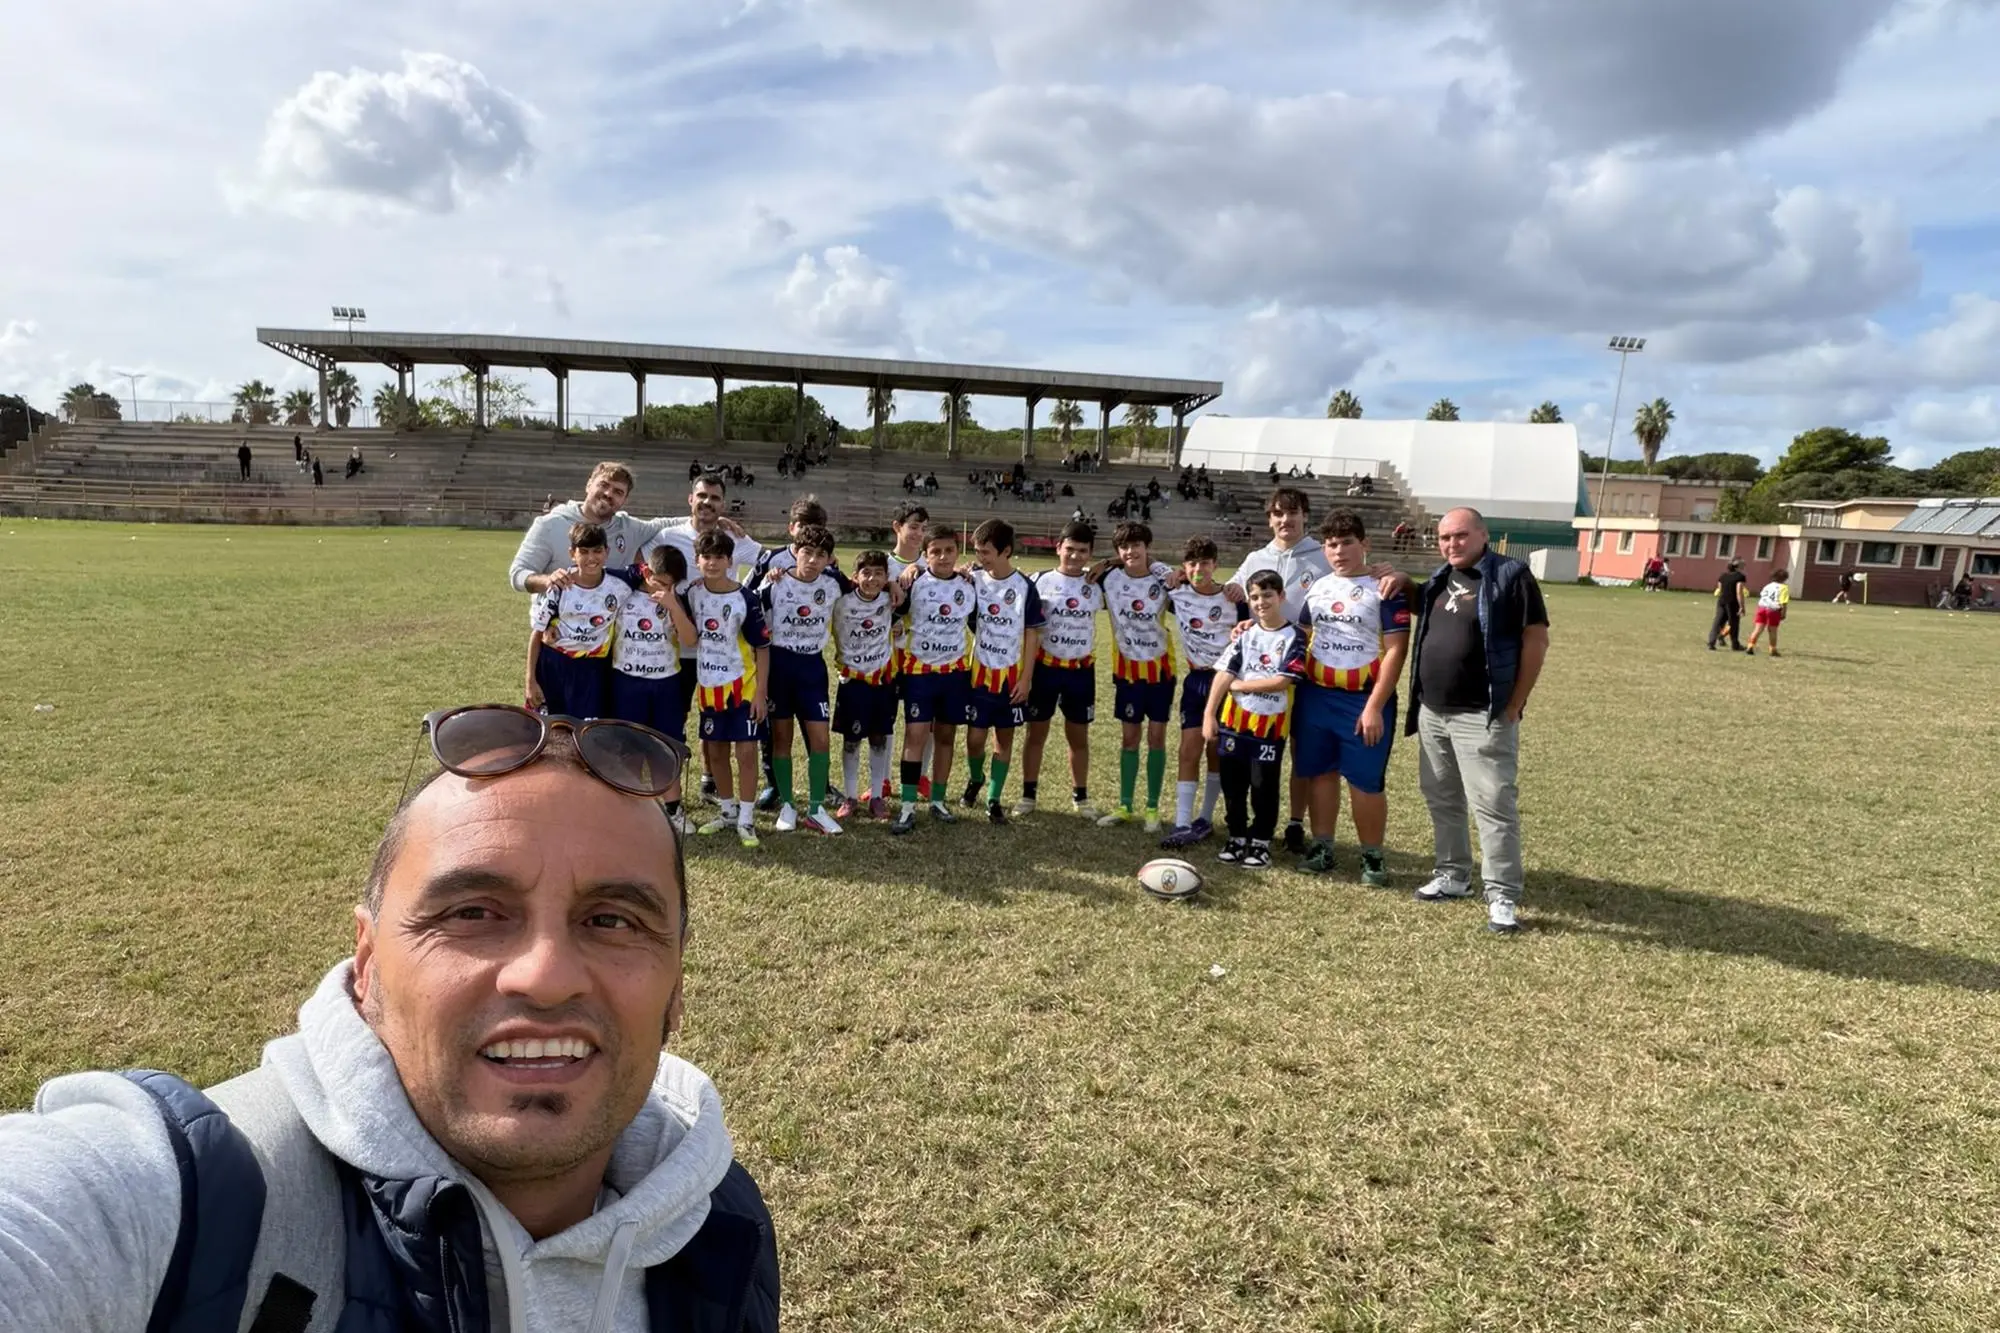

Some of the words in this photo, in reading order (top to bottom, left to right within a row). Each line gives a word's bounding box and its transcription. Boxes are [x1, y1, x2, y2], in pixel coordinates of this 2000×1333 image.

[978, 611, 1012, 625] Aragon
[1052, 607, 1091, 618] Aragon
[782, 615, 825, 627] Aragon
[624, 630, 668, 642] Aragon
[699, 631, 727, 642] ragon
[1061, 637, 1087, 646] Mara
[932, 644, 958, 652] Mara
[1331, 642, 1364, 651] Mara
[635, 665, 665, 673] Mara
[701, 662, 728, 672] Mara
[1012, 708, 1023, 723] 21
[747, 719, 758, 736] 17
[1259, 745, 1276, 761] 25
